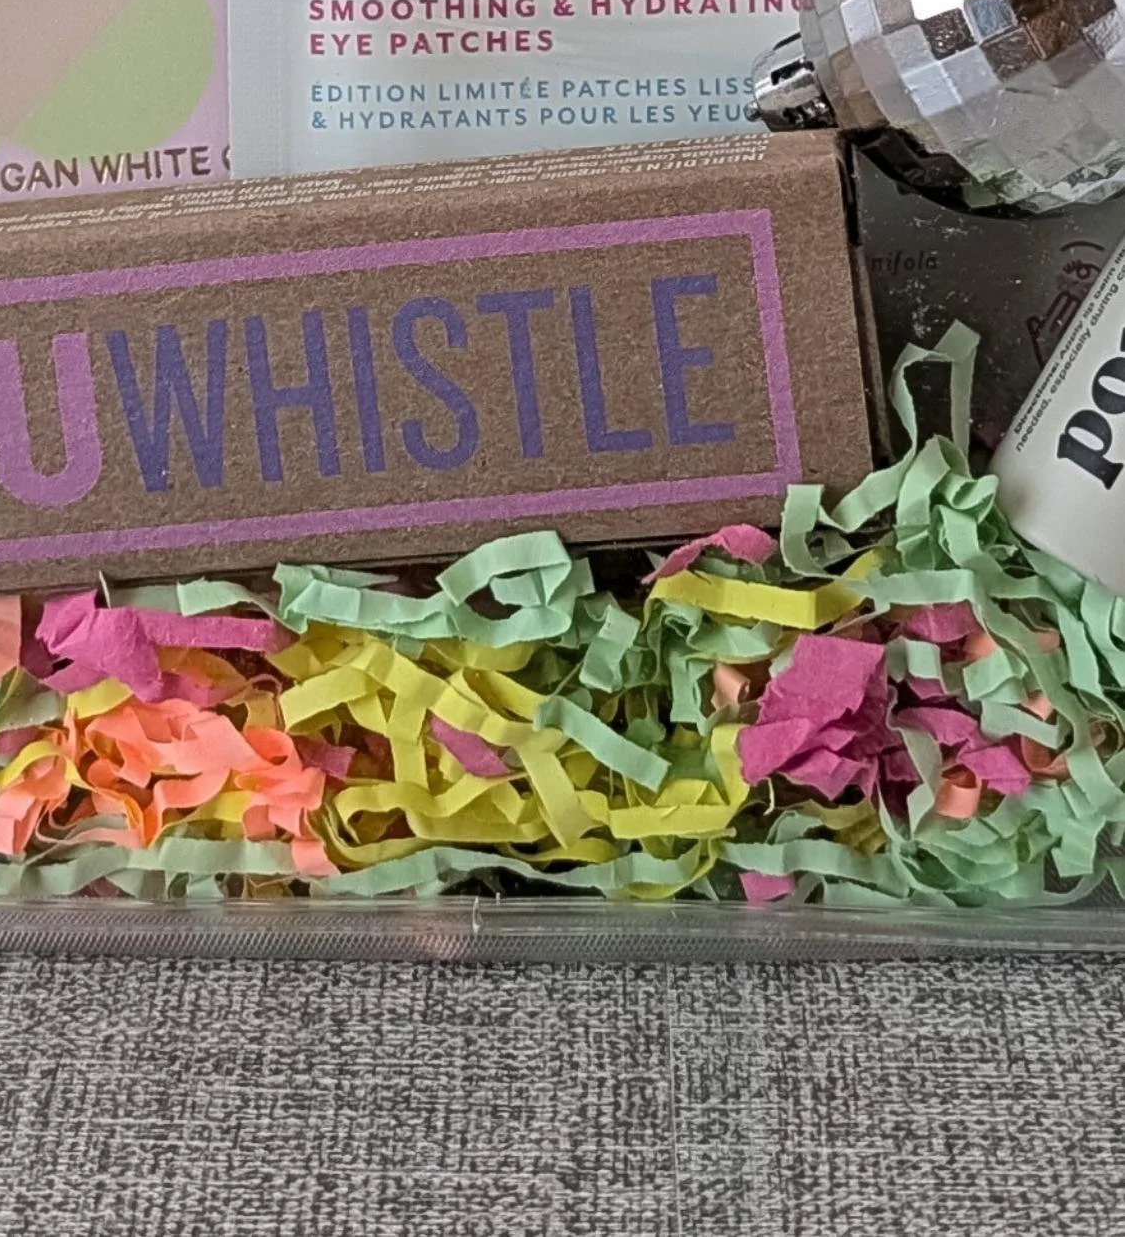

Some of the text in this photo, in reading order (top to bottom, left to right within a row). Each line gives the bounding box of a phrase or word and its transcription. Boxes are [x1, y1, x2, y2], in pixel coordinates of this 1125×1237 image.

[310, 29, 554, 55] EYE PATCHES
[311, 77, 753, 102] ÉDITION LIMITÉE PATCHES LISS
[311, 104, 747, 129] & HYDRATANTS POUR LES YEU
[91, 146, 211, 184] WHITE
[1050, 328, 1091, 394] especially
[1090, 284, 1119, 325] during
[1057, 327, 1125, 490] po
